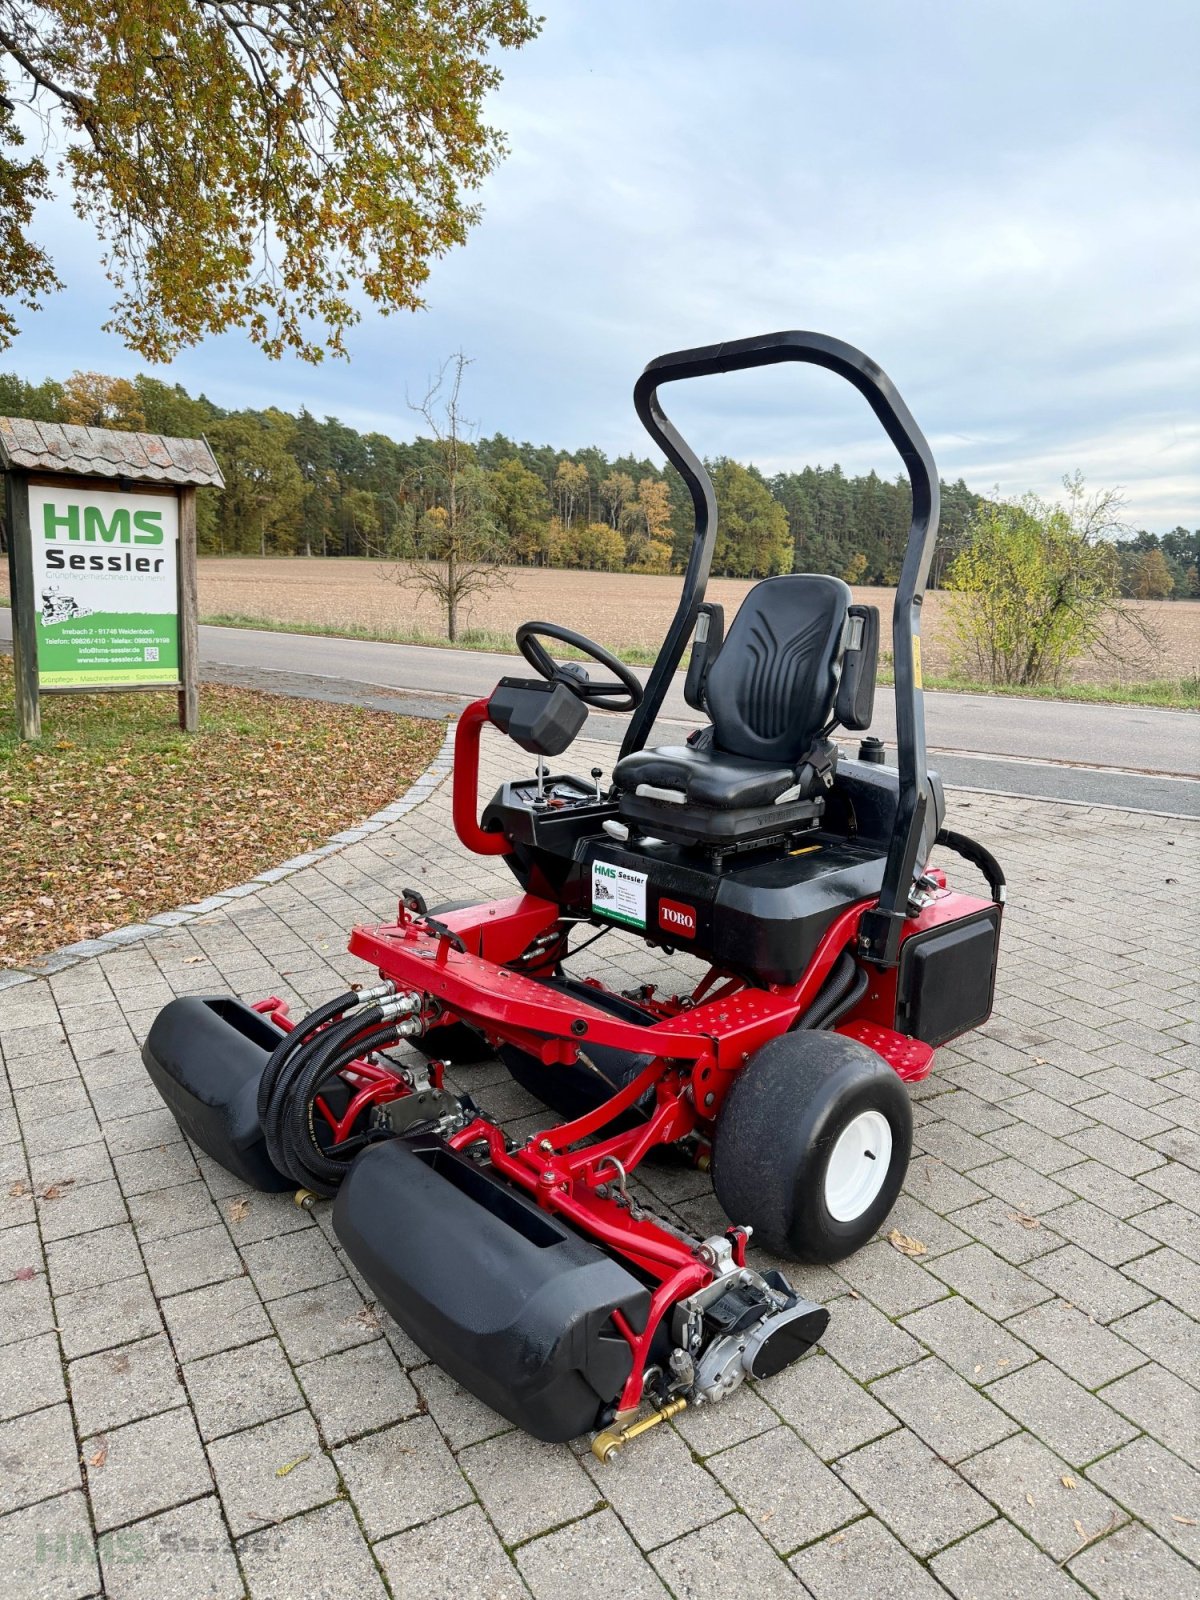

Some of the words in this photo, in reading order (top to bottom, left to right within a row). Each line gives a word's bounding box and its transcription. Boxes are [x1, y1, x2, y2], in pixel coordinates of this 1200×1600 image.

[43, 503, 164, 545] HMS
[45, 549, 165, 573] Sessler
[76, 656, 143, 664] www.hms-sessler.de
[594, 864, 617, 879] HMS
[618, 871, 645, 884] Sessler
[661, 907, 693, 927] TORO
